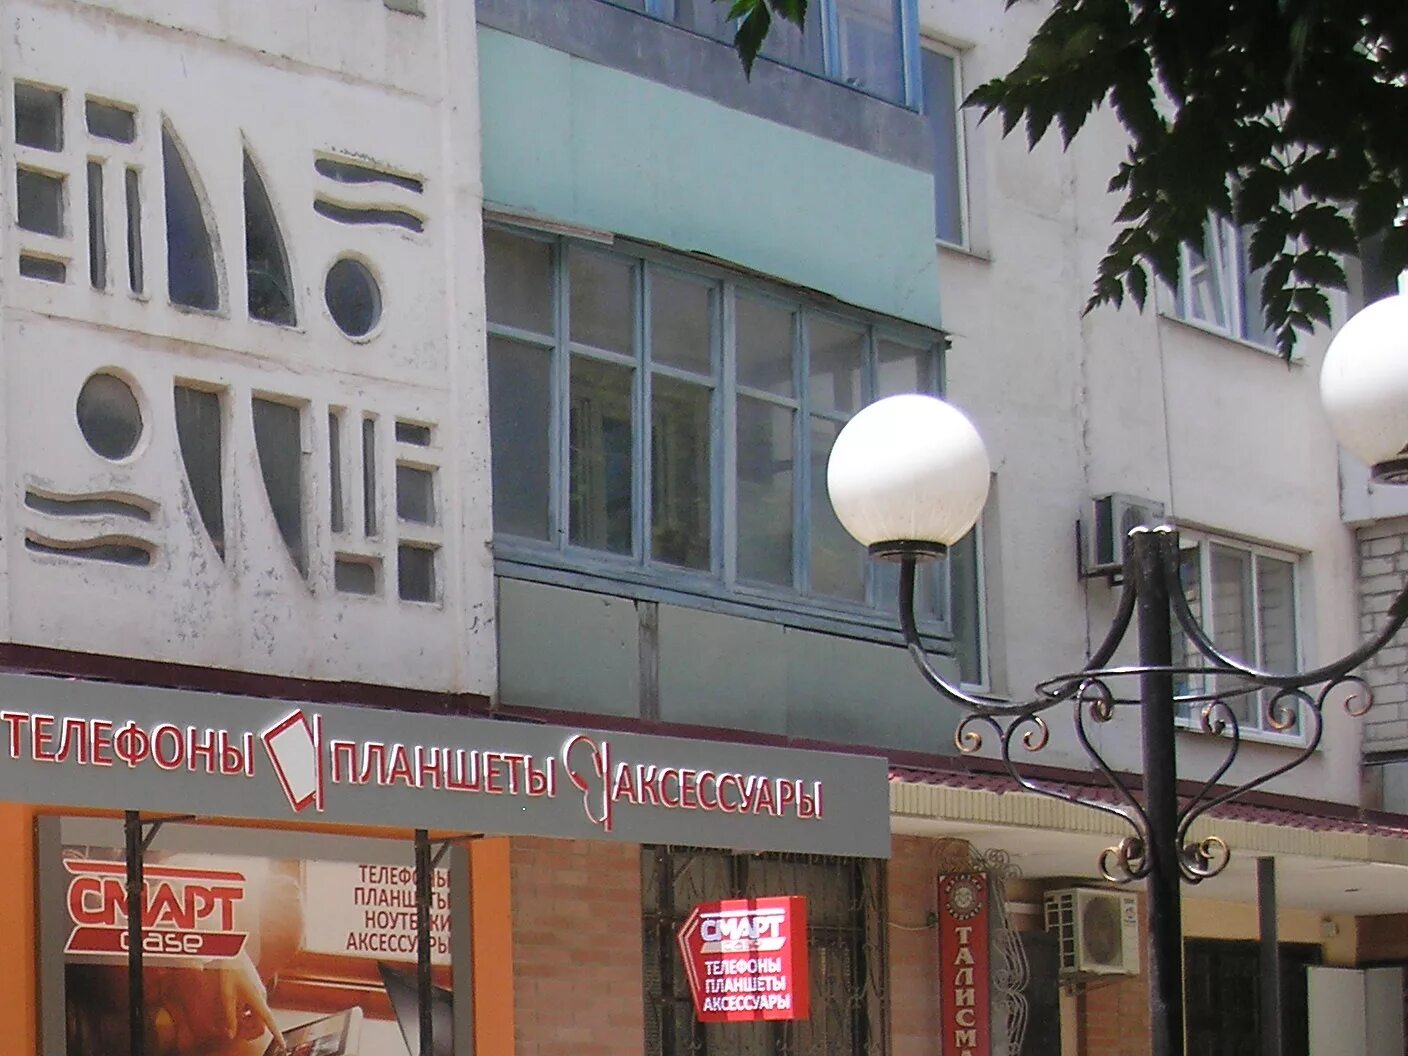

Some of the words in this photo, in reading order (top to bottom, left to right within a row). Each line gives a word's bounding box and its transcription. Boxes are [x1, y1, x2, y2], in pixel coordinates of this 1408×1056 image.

[329, 737, 558, 799] ПЛАНШЕТЫ
[610, 759, 824, 821] АКСЕССУАРЫ
[358, 864, 451, 889] ТЕЛЕФЫ
[354, 886, 451, 910] ПЛАНШТЫ
[364, 910, 452, 932] НОУТБКИ
[346, 931, 452, 955] АКСЕССУРЫ
[704, 957, 782, 976] ТЕЛЕФОНЫ
[704, 975, 787, 994] ПЛАНШЕТЫ
[703, 993, 791, 1012] АКСЕССУАРЫ
